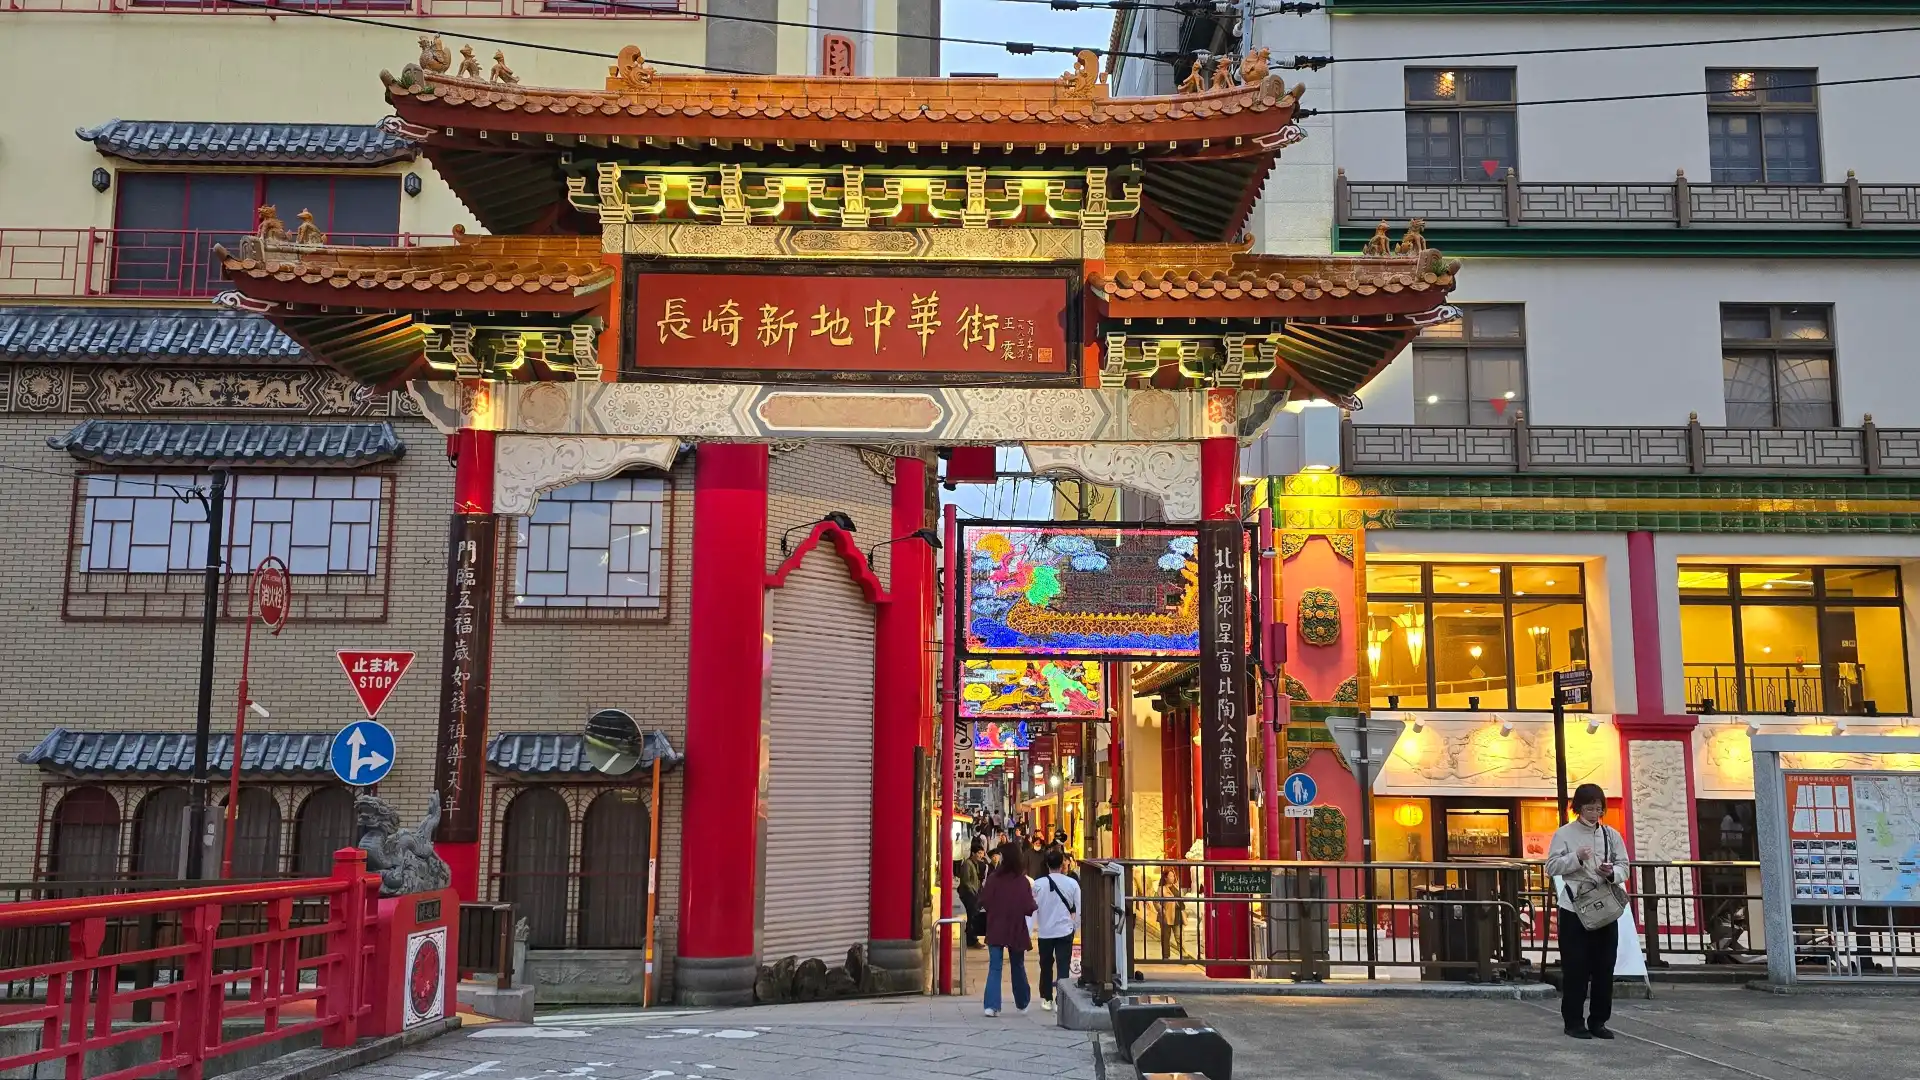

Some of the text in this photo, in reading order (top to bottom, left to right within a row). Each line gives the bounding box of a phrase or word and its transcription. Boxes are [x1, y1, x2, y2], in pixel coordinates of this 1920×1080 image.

[656, 290, 1000, 358] 長崎新地中華街
[261, 583, 283, 609] 消火栓
[352, 657, 400, 673] 止まれ
[360, 676, 392, 689] STOP
